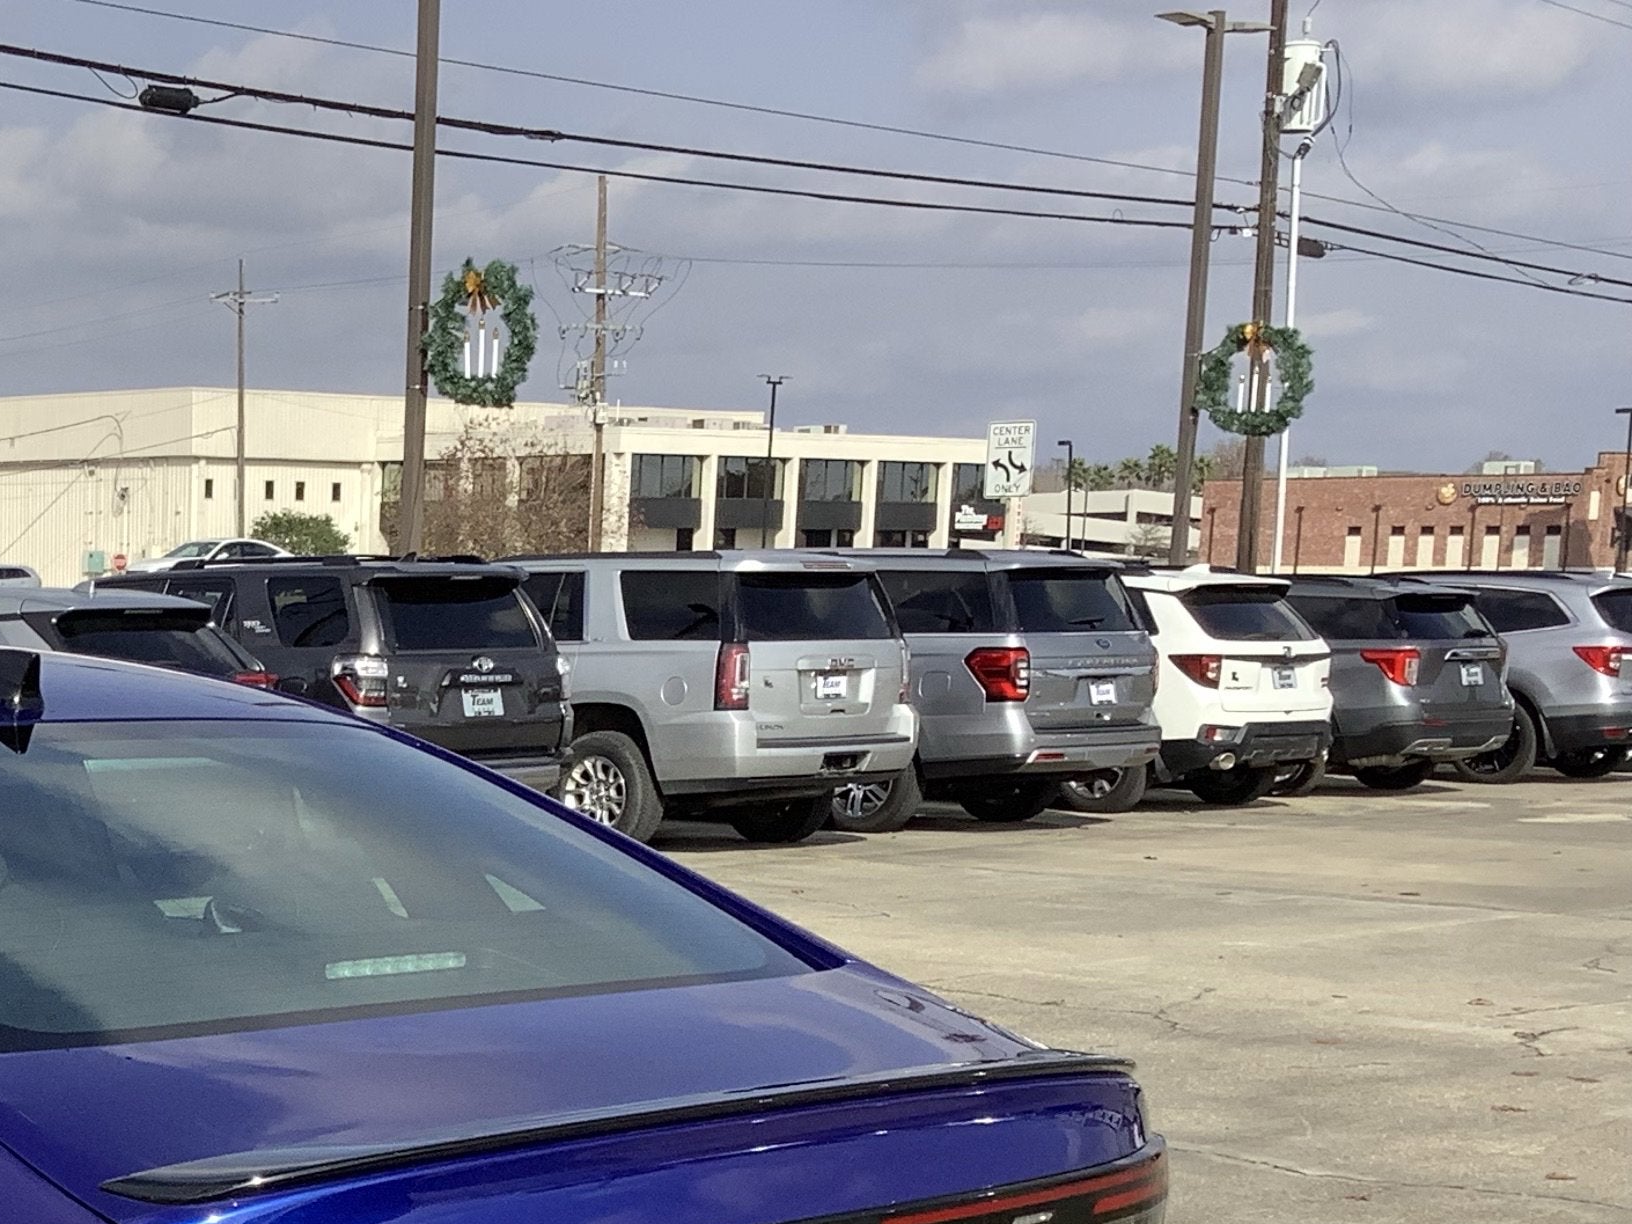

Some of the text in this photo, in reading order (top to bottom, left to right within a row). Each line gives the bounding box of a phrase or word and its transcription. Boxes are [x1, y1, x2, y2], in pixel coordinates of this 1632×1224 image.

[993, 426, 1030, 435] CENTER
[998, 437, 1024, 446] LANE
[994, 484, 1020, 493] ONLY
[1463, 483, 1535, 494] DUMPLING
[1554, 482, 1582, 493] BAO
